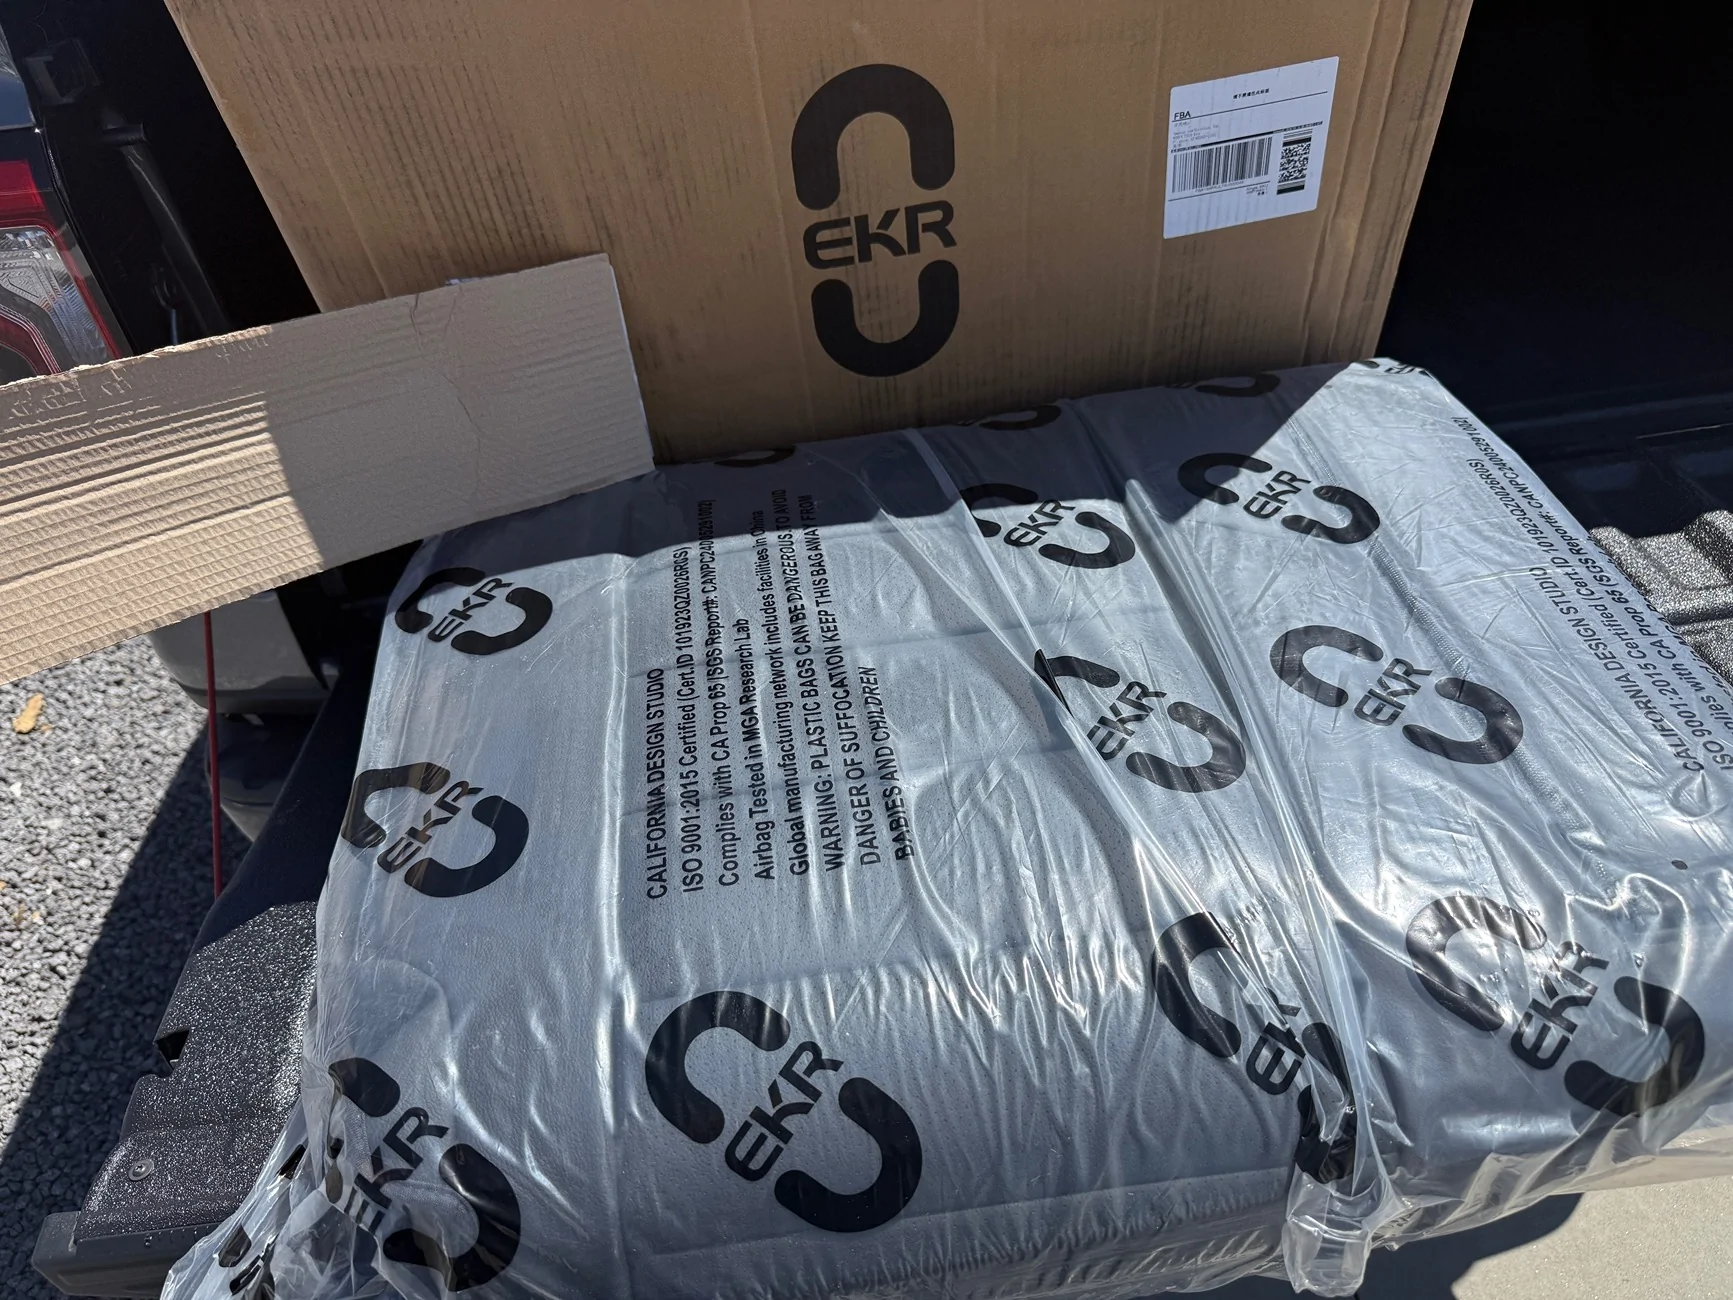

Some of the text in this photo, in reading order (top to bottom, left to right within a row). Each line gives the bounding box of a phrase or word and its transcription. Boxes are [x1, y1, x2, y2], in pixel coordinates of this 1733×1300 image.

[1174, 111, 1191, 120] FBA
[803, 200, 957, 270] EKR
[772, 489, 790, 514] AVOID
[775, 515, 791, 531] TO
[1004, 499, 1076, 547] EKR
[1243, 471, 1311, 519] EKR
[428, 578, 514, 642] EKR
[788, 603, 806, 624] BE
[1529, 567, 1579, 615] STUDIO
[1605, 590, 1630, 604] 65
[702, 594, 725, 648] Report#:
[791, 623, 812, 655] CAN
[1567, 616, 1626, 672] DESIGN
[1588, 603, 1647, 660] Certified
[1623, 606, 1659, 637] Prop
[1649, 639, 1676, 660] CA
[1671, 663, 1706, 692] with
[708, 684, 726, 700] 65
[751, 510, 810, 876] Global manufacturing network includes facilities in China
[797, 657, 819, 699] BAGS
[797, 494, 881, 865] DANGER OF SUFFOCATION KEEP THIS BAG AWAY FROM
[1354, 658, 1432, 726] EKR
[1637, 662, 1712, 738] 9001:2015
[678, 703, 698, 767] Certified
[709, 702, 731, 737] Prop
[802, 700, 830, 770] PLASTIC
[1087, 681, 1167, 760] EKR
[1614, 672, 1705, 772] CALIFORNIA
[711, 738, 730, 761] CA
[733, 618, 775, 880] Airbag Tested in MGA Research Lab
[858, 666, 915, 861] BABIES AND CHILDREN
[647, 668, 667, 899] CALIFORNIA DESIGN STUDIO
[714, 764, 733, 798] with
[377, 780, 484, 873] EKR
[680, 769, 701, 857] 9001:2015
[814, 773, 845, 872] WARNING:
[716, 802, 741, 886] Complies
[682, 859, 703, 892] ISO
[1511, 941, 1609, 1070] EKR
[725, 1041, 844, 1181] EKR
